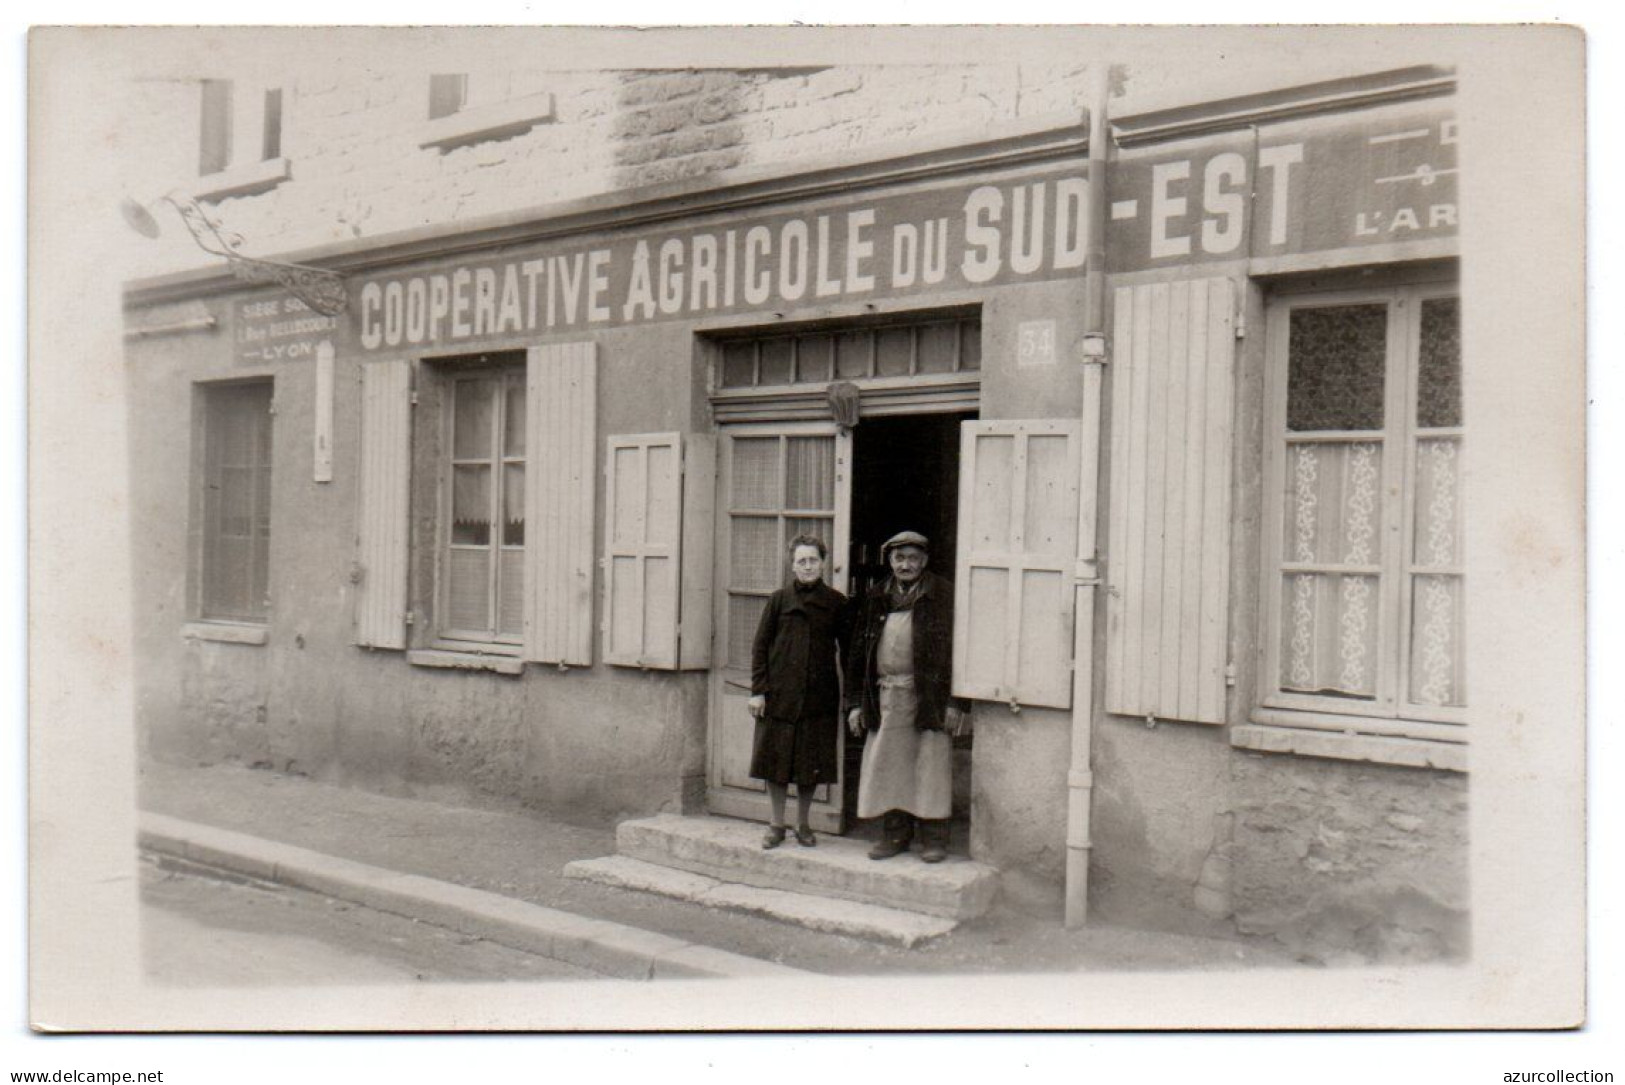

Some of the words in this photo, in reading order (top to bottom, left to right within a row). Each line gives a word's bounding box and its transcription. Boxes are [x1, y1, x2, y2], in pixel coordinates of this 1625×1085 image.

[361, 249, 611, 350] COOPÉRATIVE
[622, 208, 876, 322] AGRICOLE
[892, 217, 948, 288] DU
[262, 341, 312, 360] LYON
